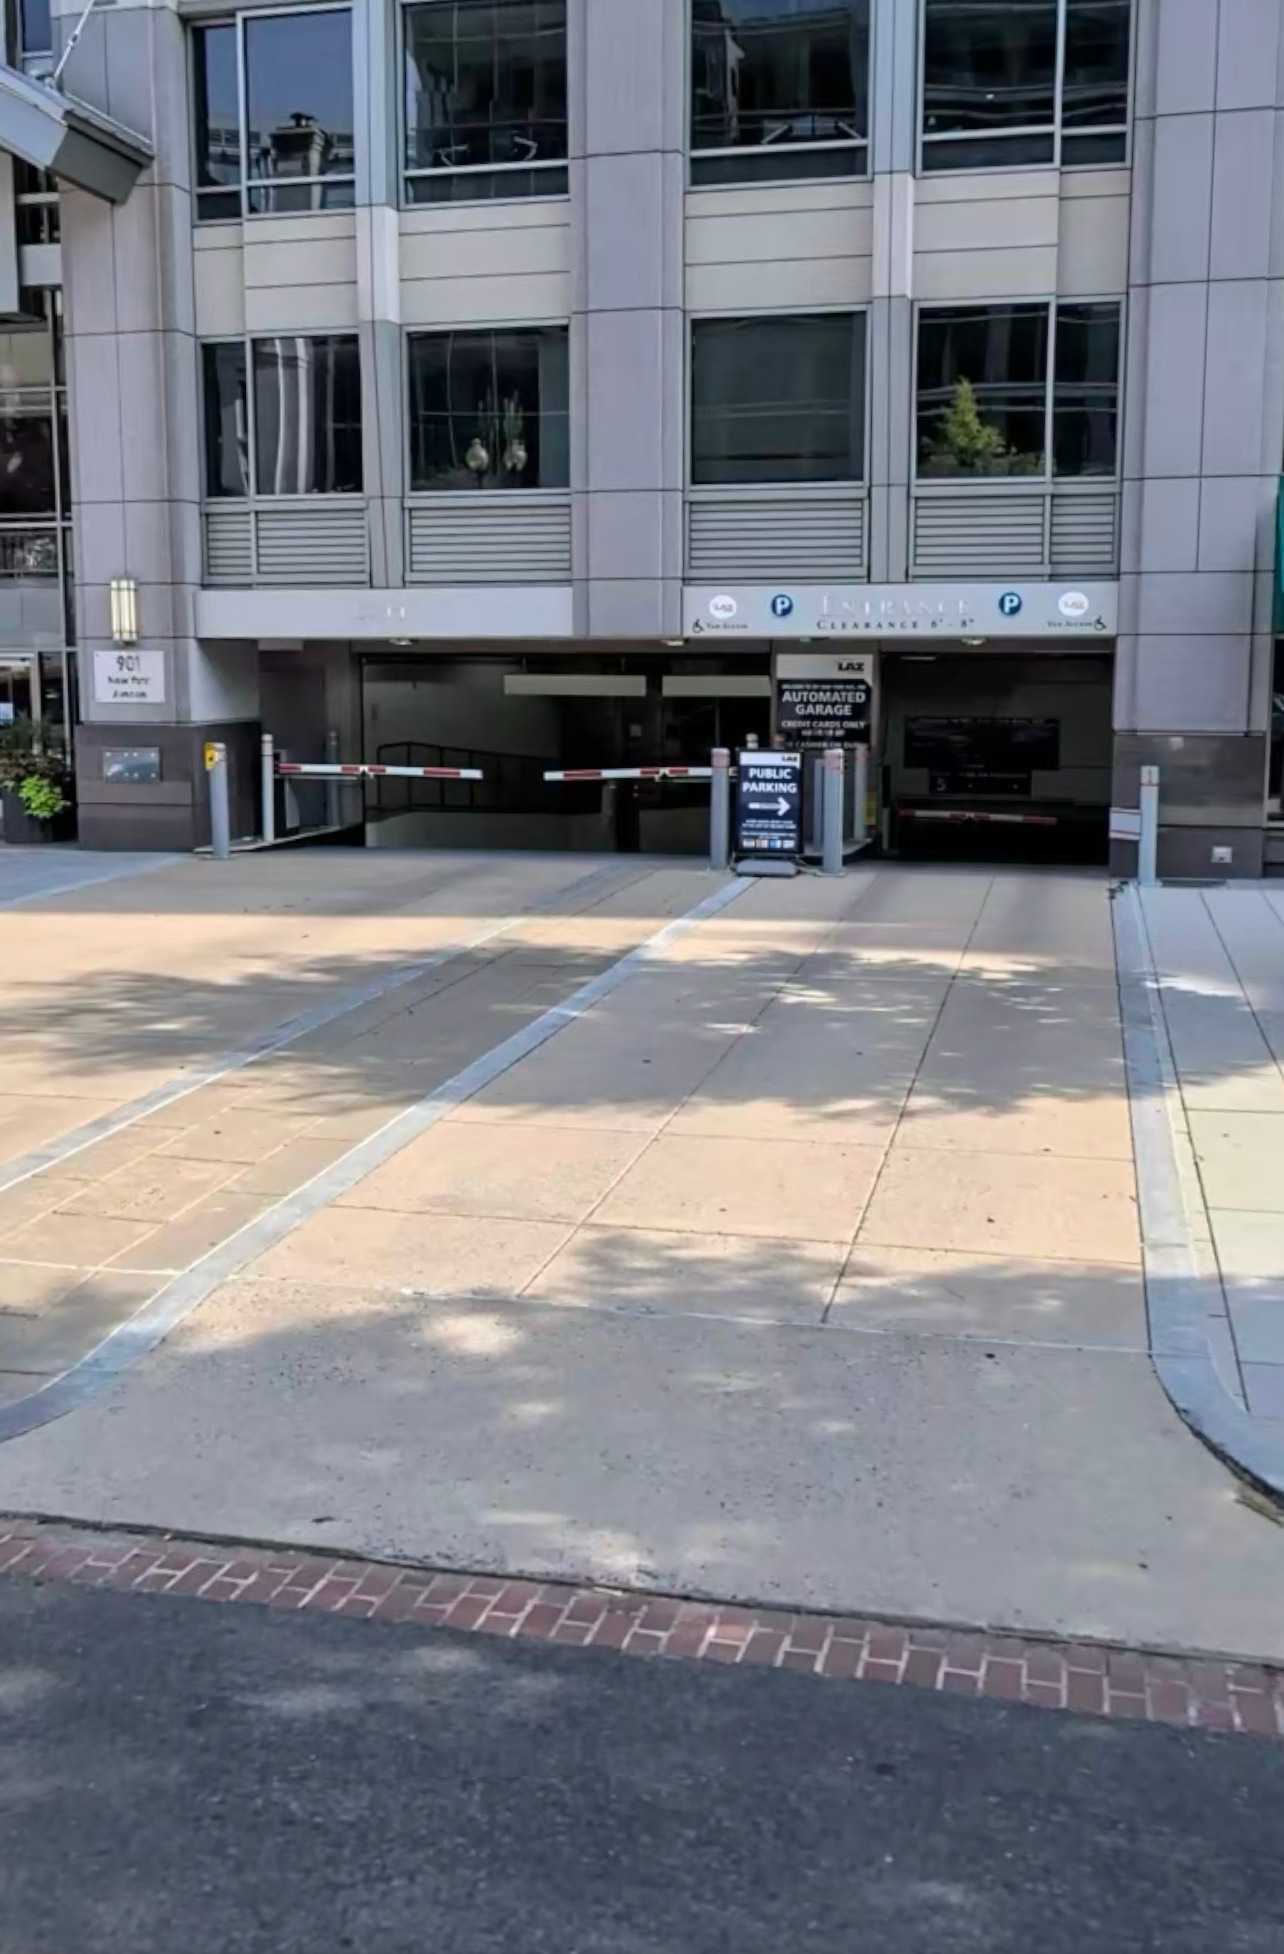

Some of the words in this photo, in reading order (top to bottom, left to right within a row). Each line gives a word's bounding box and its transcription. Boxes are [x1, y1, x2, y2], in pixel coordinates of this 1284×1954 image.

[838, 662, 864, 672] LAZ
[782, 691, 866, 703] AUTOMATED
[795, 704, 853, 716] GARAGE
[749, 767, 792, 780] PUBLIC
[742, 781, 798, 794] PARKING
